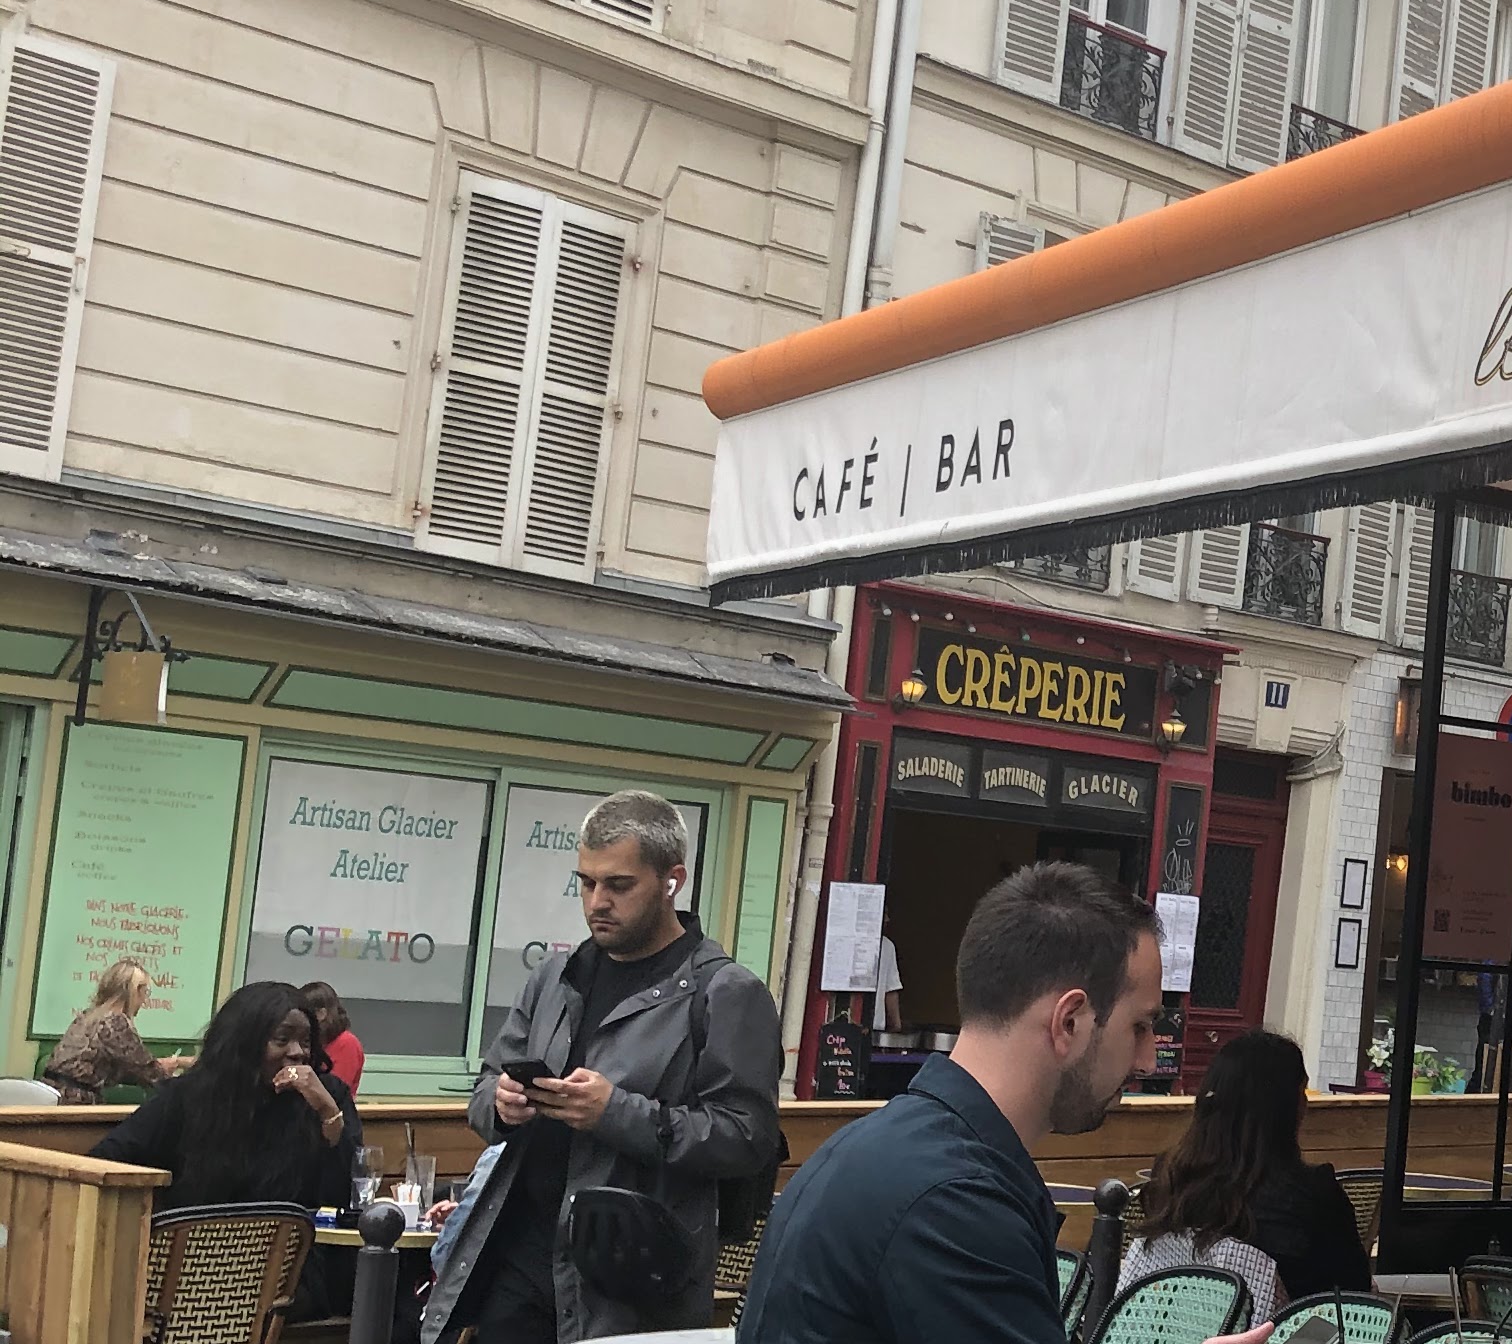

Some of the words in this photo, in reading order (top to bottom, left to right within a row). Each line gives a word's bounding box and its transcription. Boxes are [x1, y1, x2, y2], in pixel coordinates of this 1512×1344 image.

[793, 435, 880, 522] CAFÉ
[935, 417, 1015, 494] BAR
[935, 644, 1127, 733] CRÊPERIE
[897, 755, 966, 789] SALADERIE
[983, 767, 1047, 799] TARTINERIE
[1067, 774, 1140, 808] GLACIER
[1451, 780, 1512, 809] bimbo
[288, 796, 372, 832] Artisan
[377, 804, 459, 840] Glacier
[329, 848, 410, 884] Atelier
[284, 923, 436, 964] GELATO
